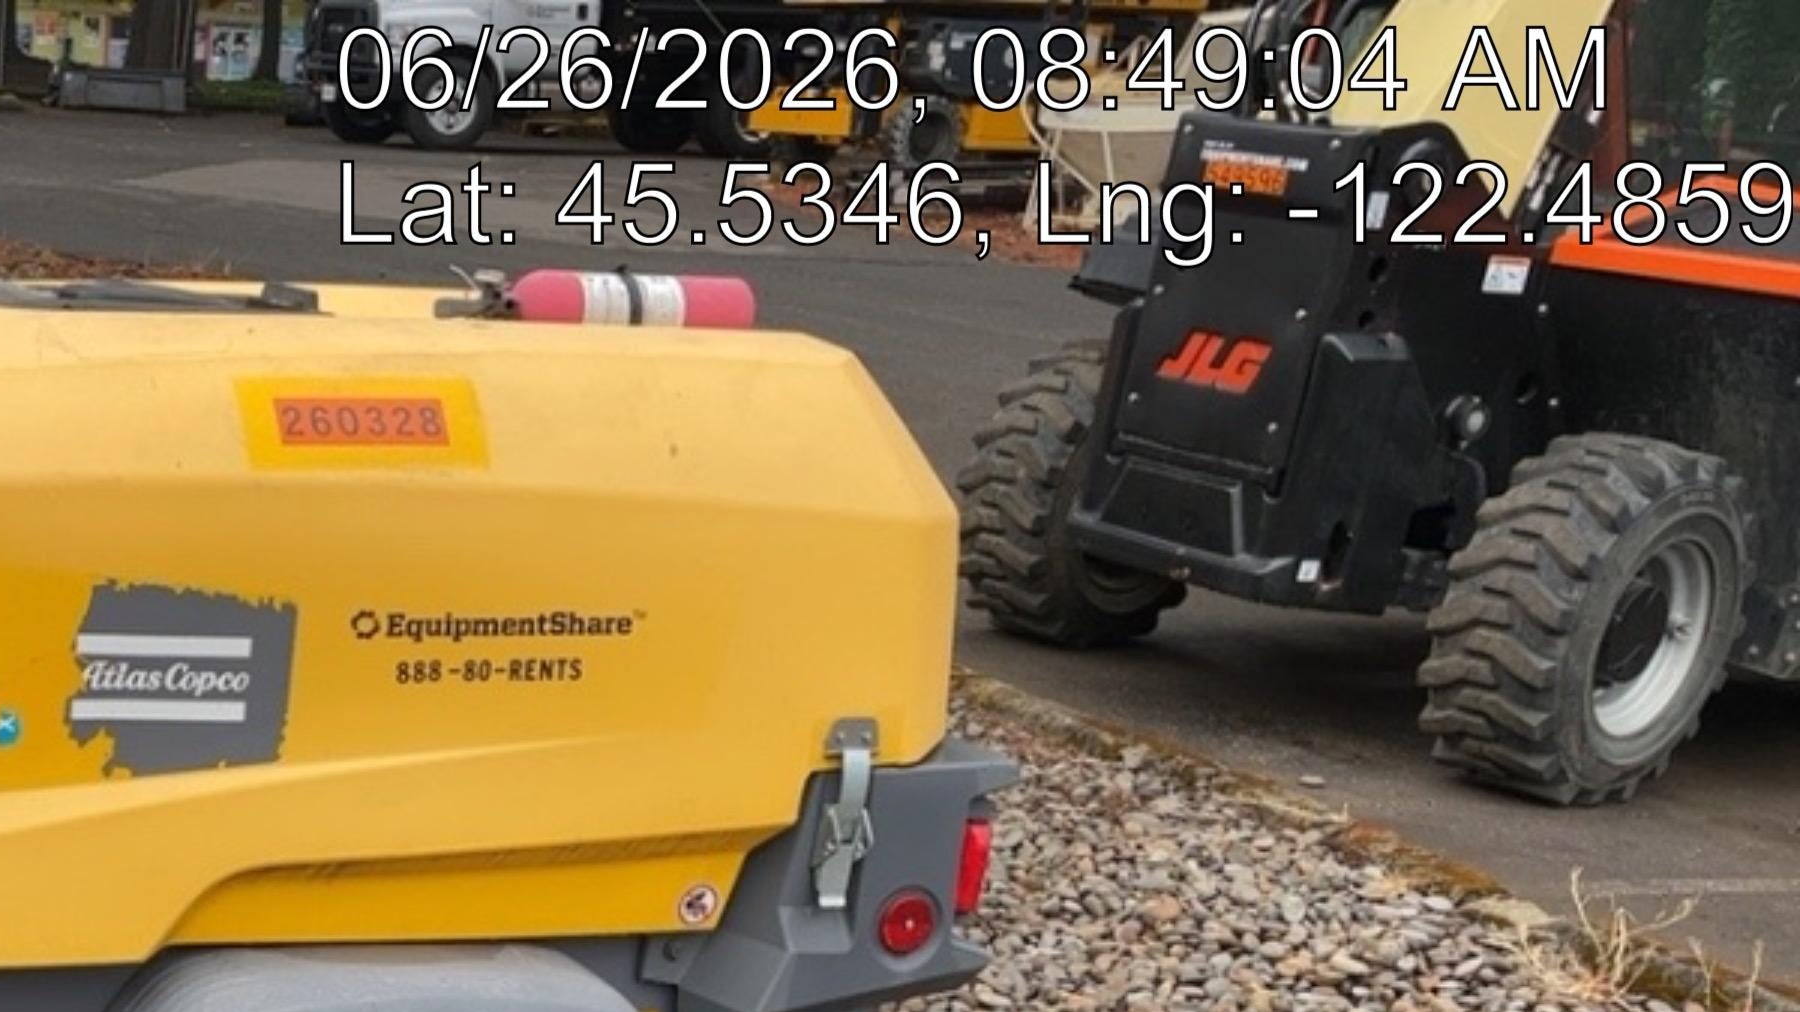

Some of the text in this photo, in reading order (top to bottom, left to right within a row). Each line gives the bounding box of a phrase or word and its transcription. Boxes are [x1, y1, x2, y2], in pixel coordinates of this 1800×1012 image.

[1155, 330, 1273, 395] JLG
[276, 405, 443, 438] 260328
[162, 661, 251, 697] Copco
[394, 656, 584, 686] 888-80-RENTS
